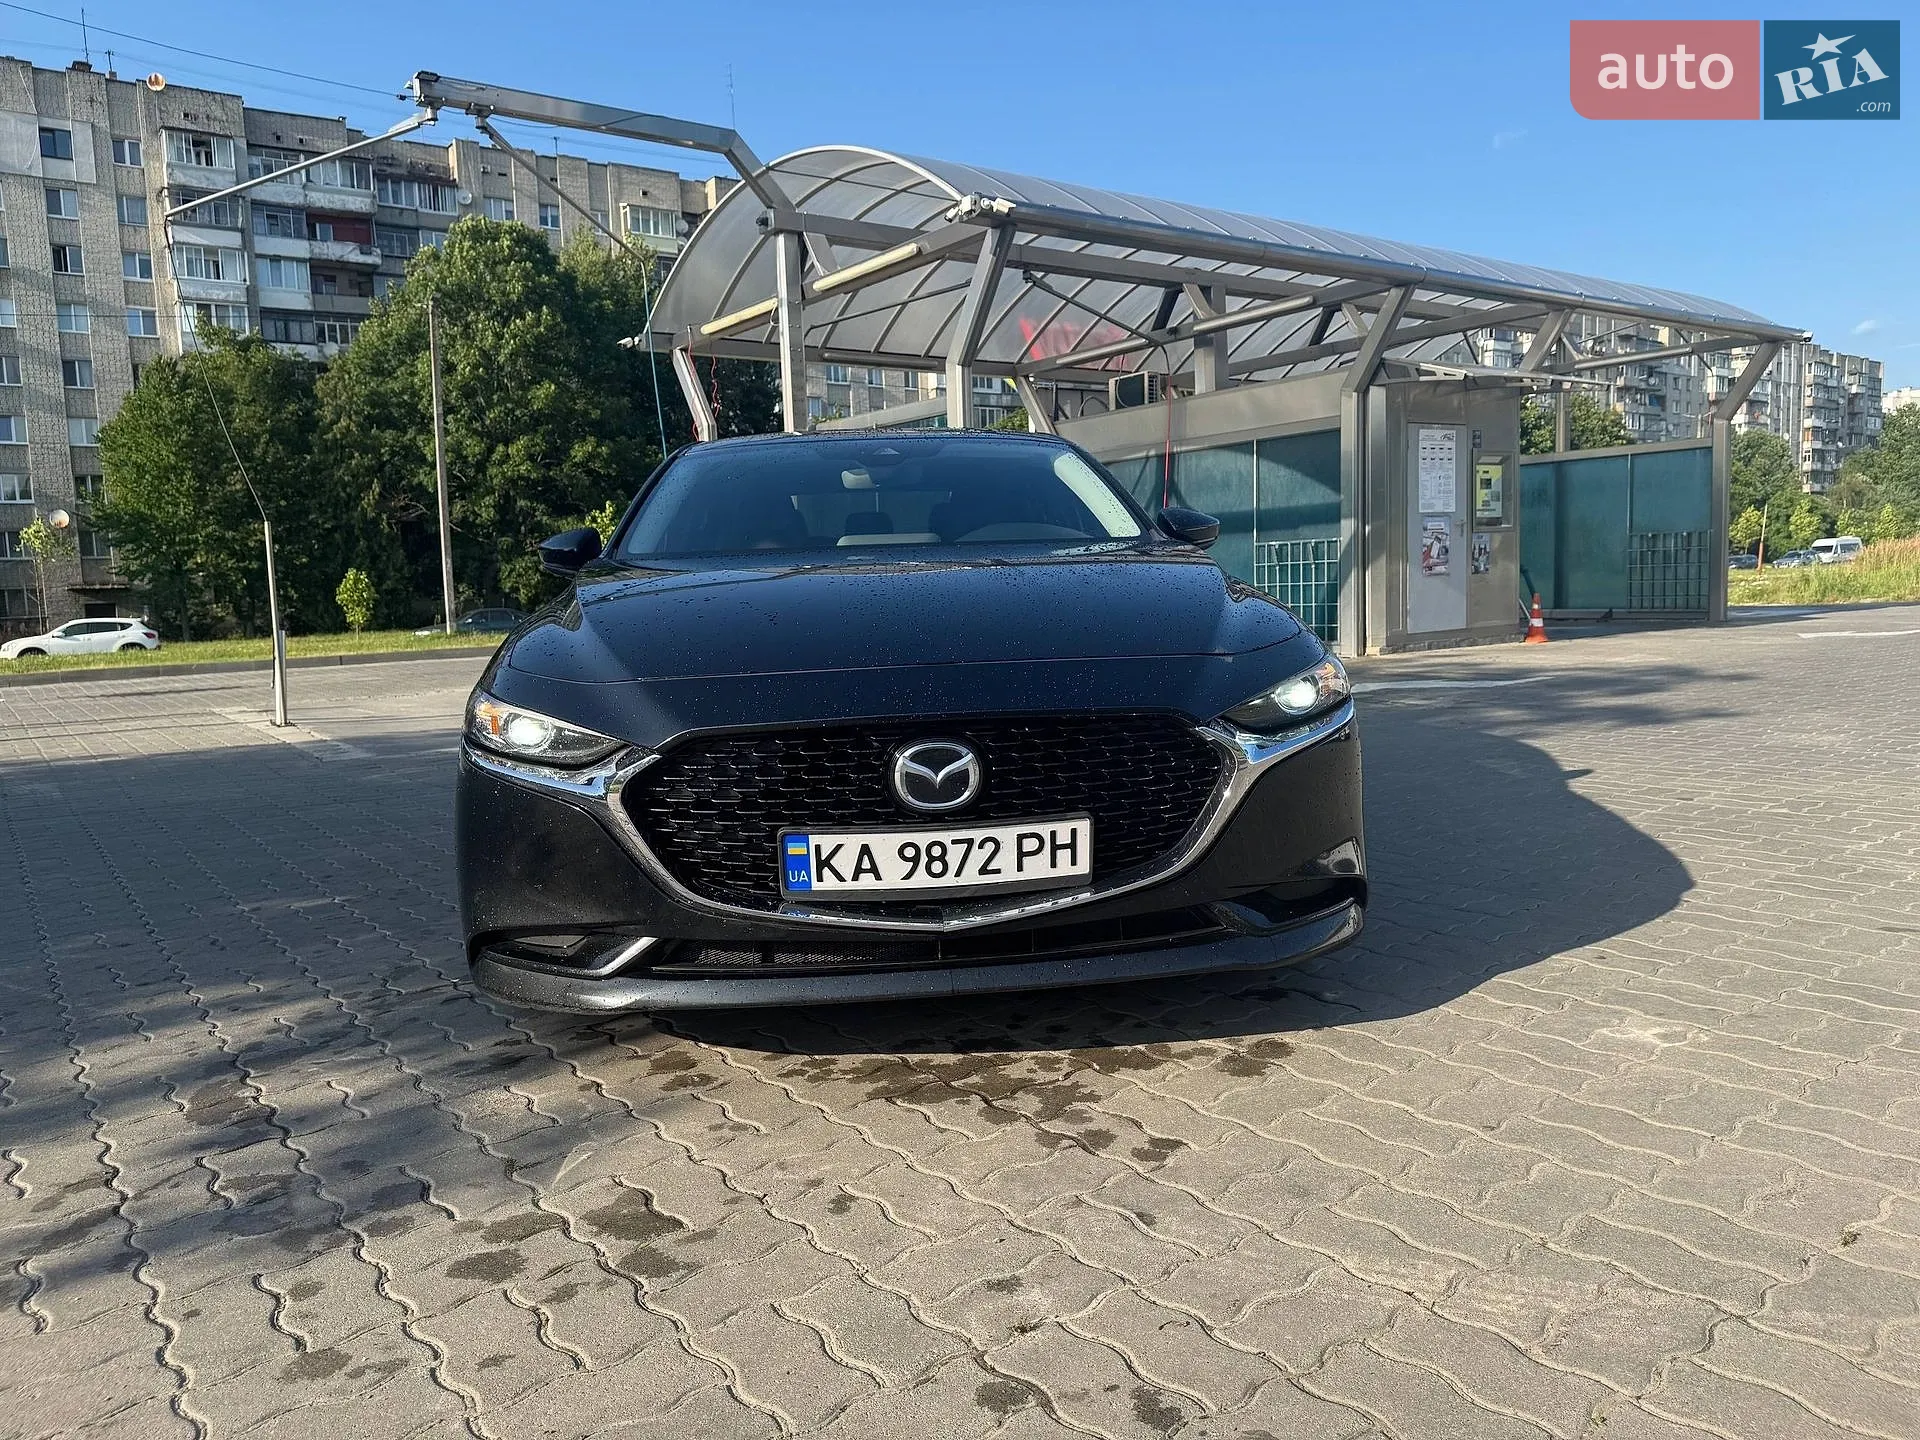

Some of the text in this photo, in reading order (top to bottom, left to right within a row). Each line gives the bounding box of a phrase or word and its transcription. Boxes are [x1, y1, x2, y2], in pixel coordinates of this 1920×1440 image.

[814, 827, 1078, 883] KA 9872 PH
[789, 870, 809, 883] UA
